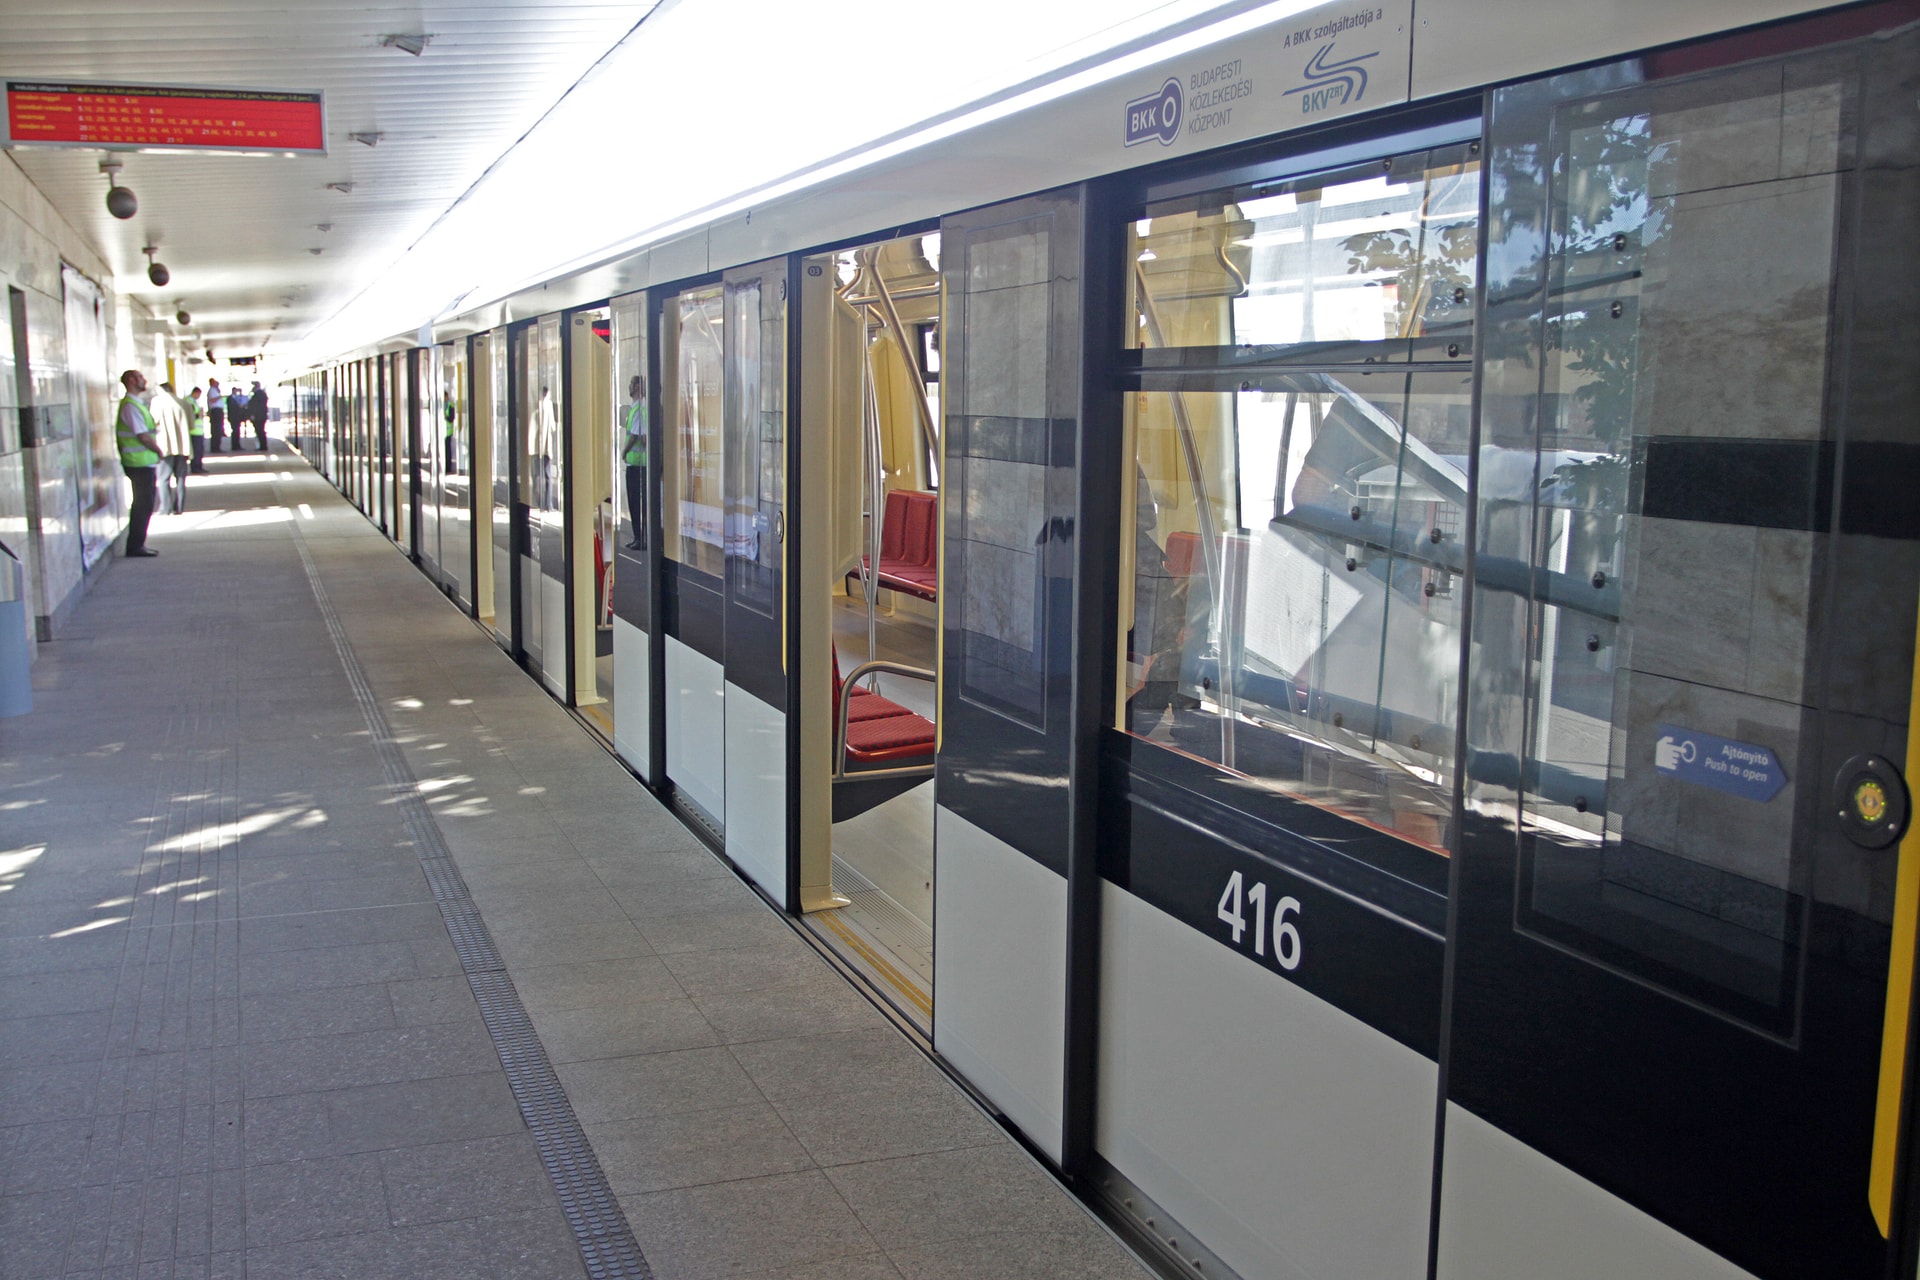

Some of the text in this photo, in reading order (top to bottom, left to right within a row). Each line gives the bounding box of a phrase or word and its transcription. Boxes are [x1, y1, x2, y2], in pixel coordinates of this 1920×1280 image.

[1283, 8, 1383, 49] A BKK szolgáltatója a
[1190, 59, 1242, 90] BUDAPESTI
[1189, 78, 1253, 113] KÖZLEKEDÉSI
[1131, 106, 1157, 133] BKK
[1188, 108, 1232, 135] KÖZPONT
[1704, 757, 1768, 783] Push to open
[1722, 745, 1769, 766] Ajtónyitó
[1217, 870, 1301, 970] 416
